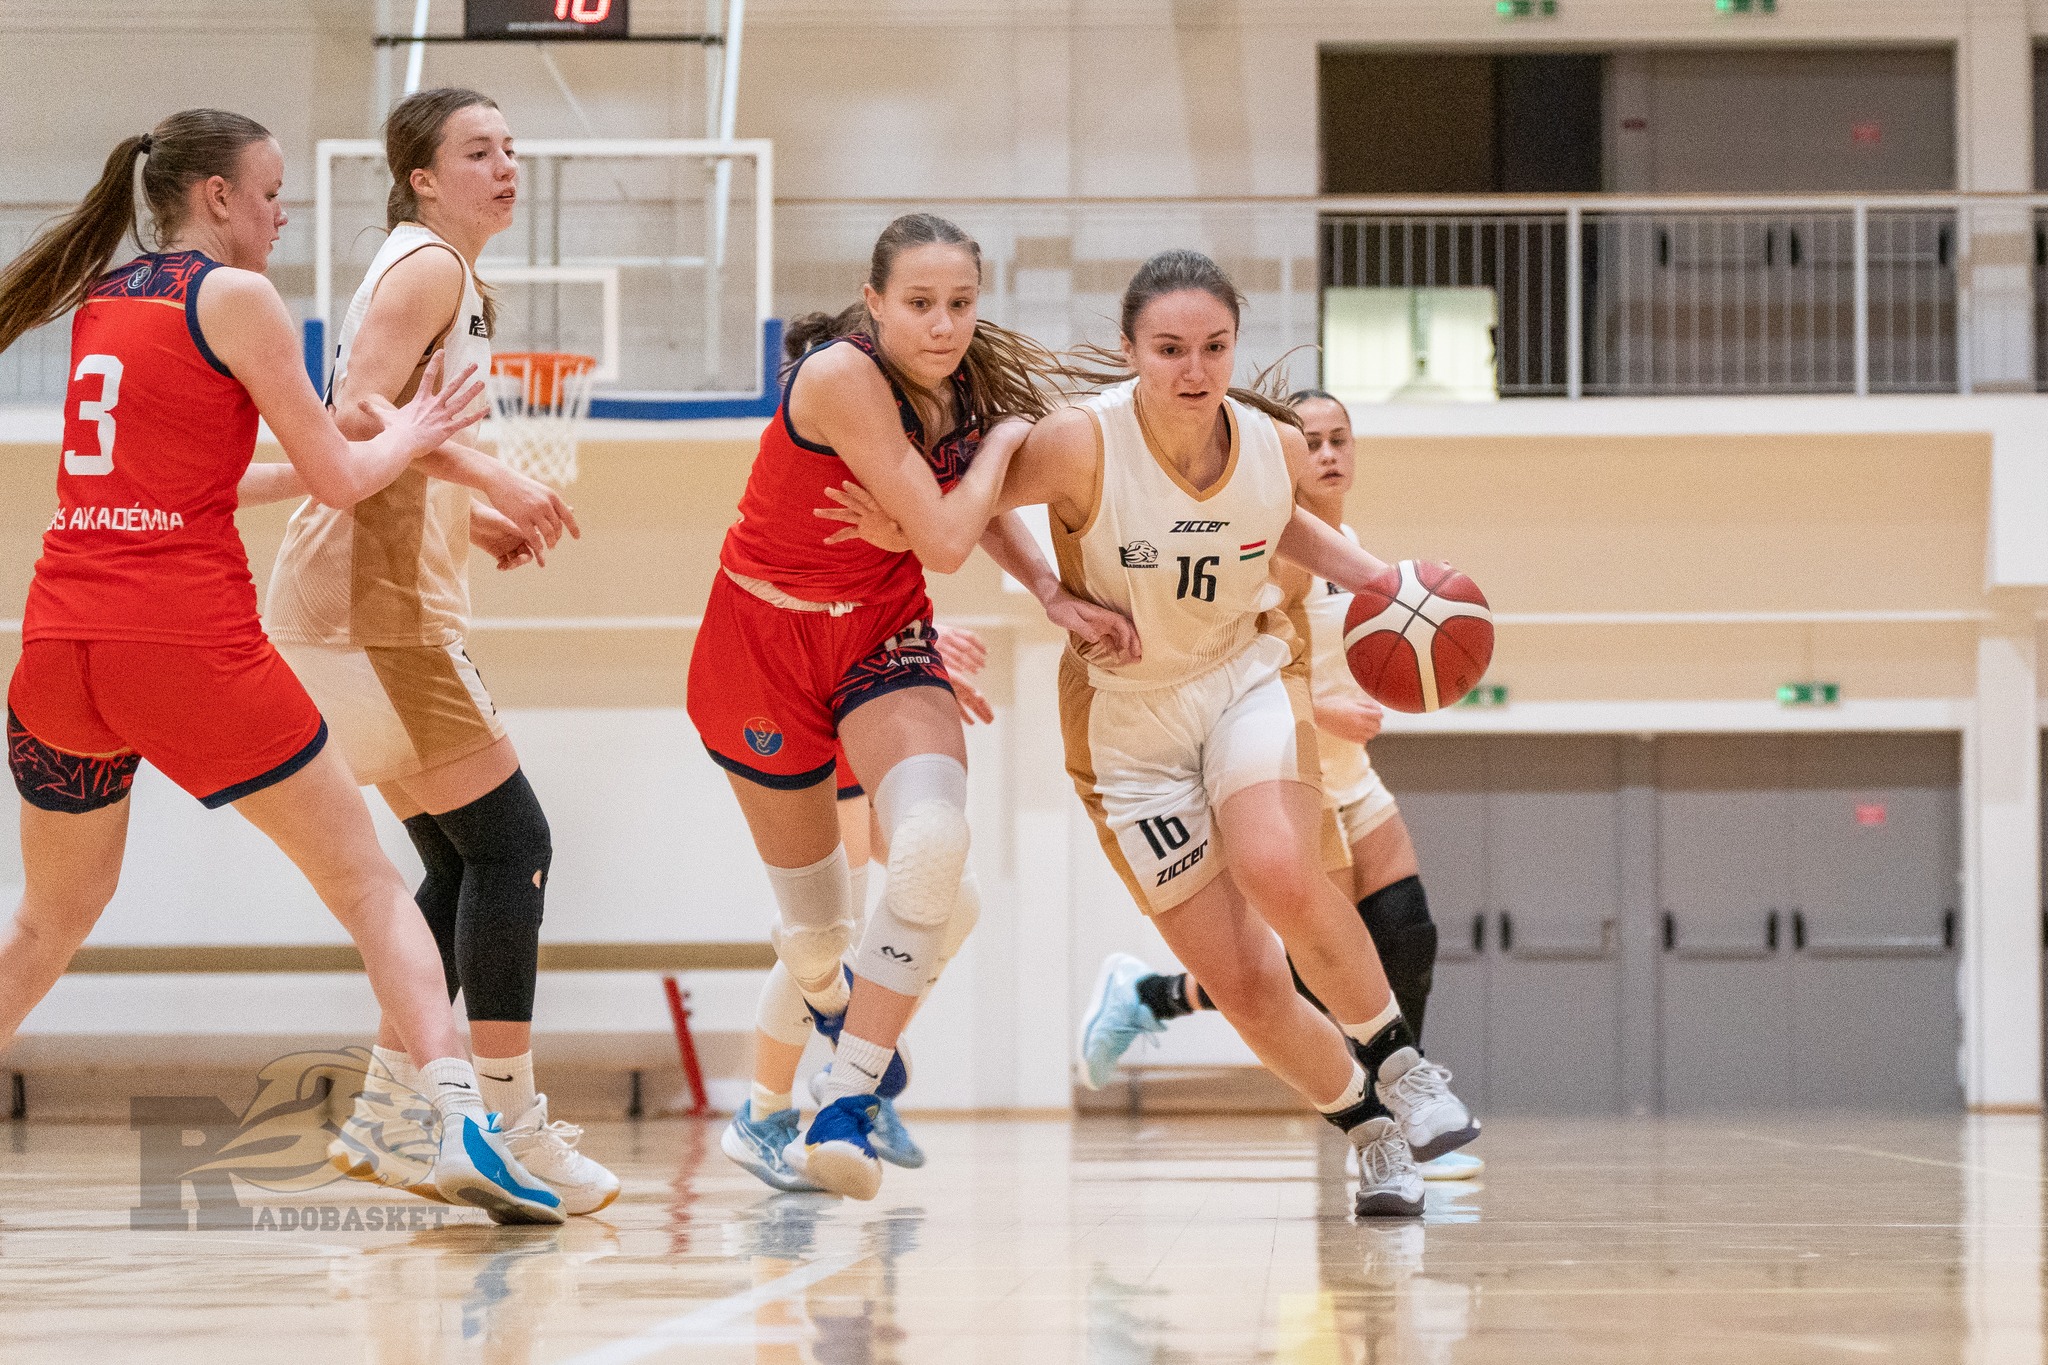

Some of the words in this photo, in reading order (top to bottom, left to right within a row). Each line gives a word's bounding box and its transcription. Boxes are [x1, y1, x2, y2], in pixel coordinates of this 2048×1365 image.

[64, 354, 124, 476] 3
[69, 502, 185, 531] AKADÉMIA
[1176, 556, 1220, 602] 16
[1135, 814, 1191, 860] 16
